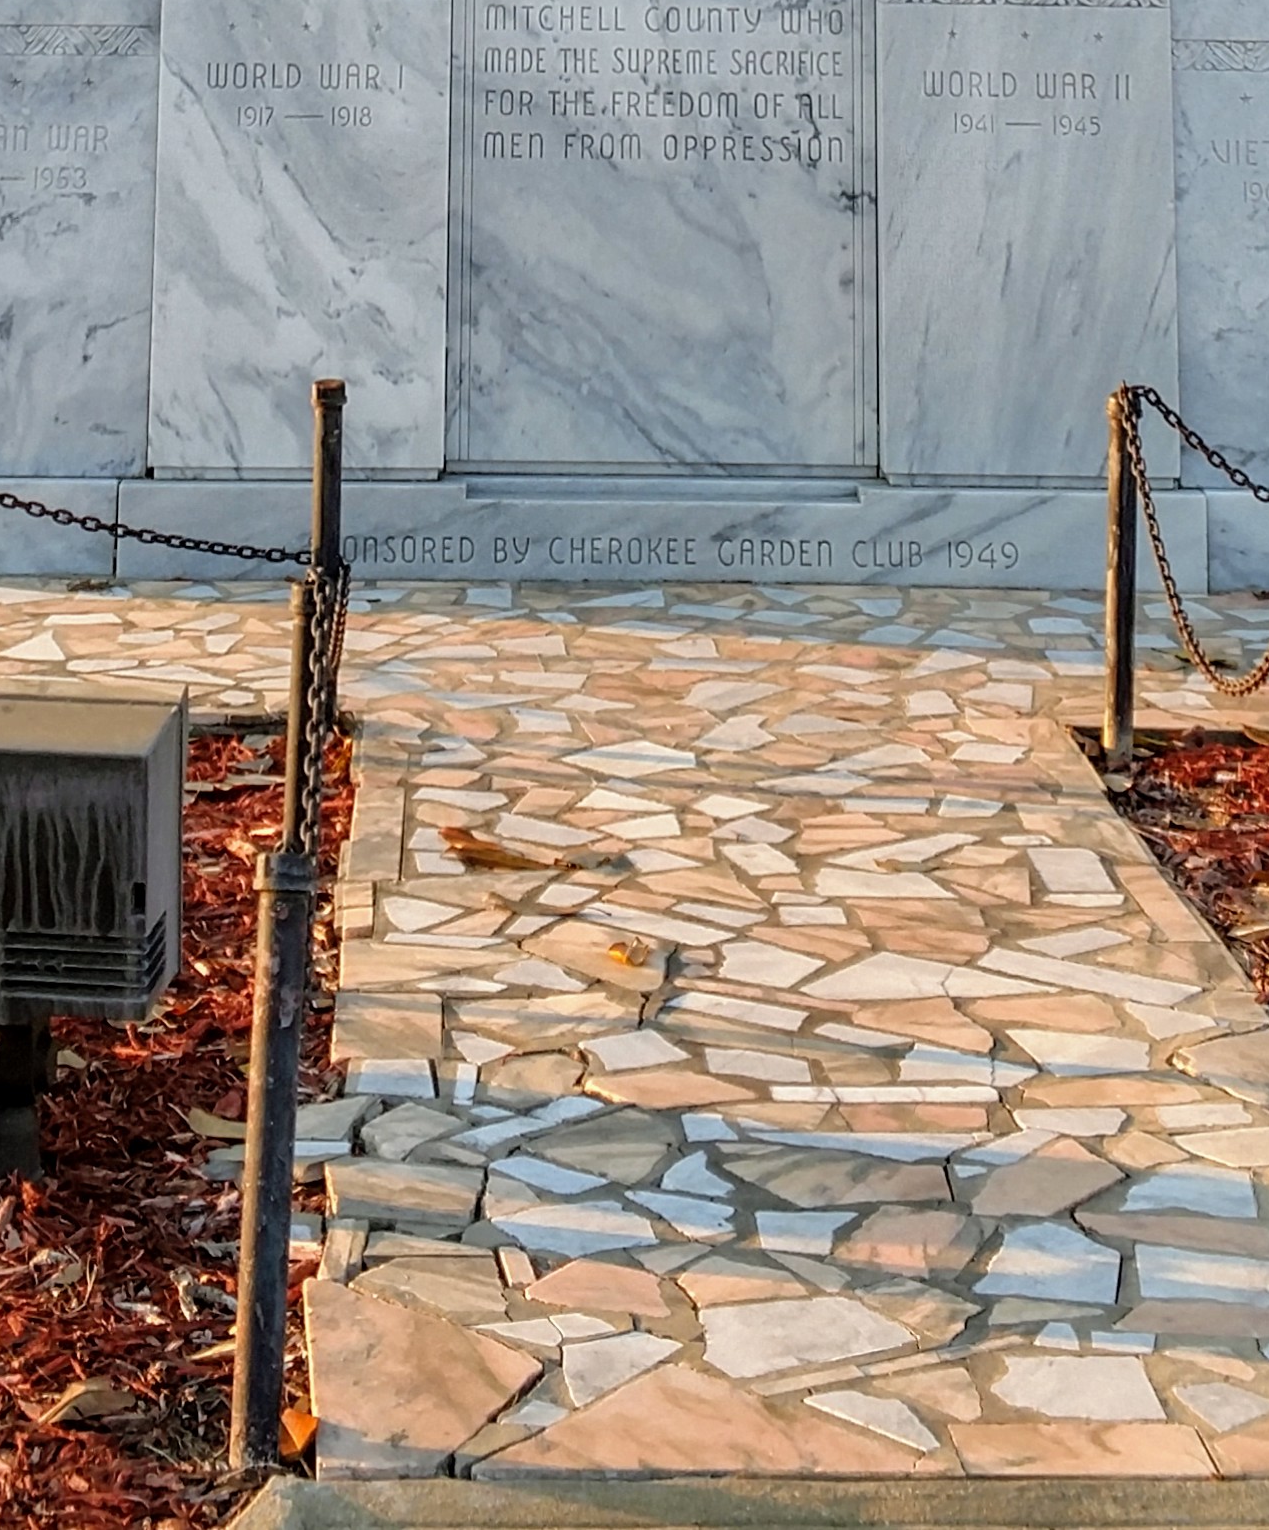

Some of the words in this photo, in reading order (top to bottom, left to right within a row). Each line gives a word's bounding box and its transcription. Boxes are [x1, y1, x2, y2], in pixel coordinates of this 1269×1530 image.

[485, 3, 627, 32] MITCHELL
[644, 6, 762, 34] COUNTY
[780, 8, 844, 36] WHO
[206, 62, 303, 90] WORLD
[319, 62, 381, 91] WAR
[398, 63, 405, 90] I
[483, 46, 547, 74] MADE
[559, 47, 600, 75] THE
[612, 46, 718, 76] SUPREME
[729, 49, 844, 78] SACRIFICE
[922, 69, 1018, 99] WORLD
[1035, 71, 1097, 100] WAR
[1114, 73, 1130, 101] II
[236, 105, 275, 128] 1917
[331, 105, 373, 128] 1918
[484, 88, 534, 117] FOR
[547, 89, 596, 117] THE
[611, 90, 739, 120] FREEDOM
[753, 92, 785, 120] OF
[796, 92, 844, 120] ALL
[47, 124, 109, 152] WAR
[953, 111, 995, 135] 1941
[1052, 114, 1102, 137] 1945
[483, 131, 545, 160] MEN
[563, 132, 643, 161] FROM
[662, 133, 844, 163] OPPRESSION
[33, 165, 88, 190] 1953
[341, 534, 475, 564] ONSORED
[493, 536, 531, 565] BY
[548, 536, 697, 567] CHEROKEE
[717, 538, 833, 568] GARDEN
[851, 540, 923, 569] CLUB
[946, 540, 1019, 570] 1949
